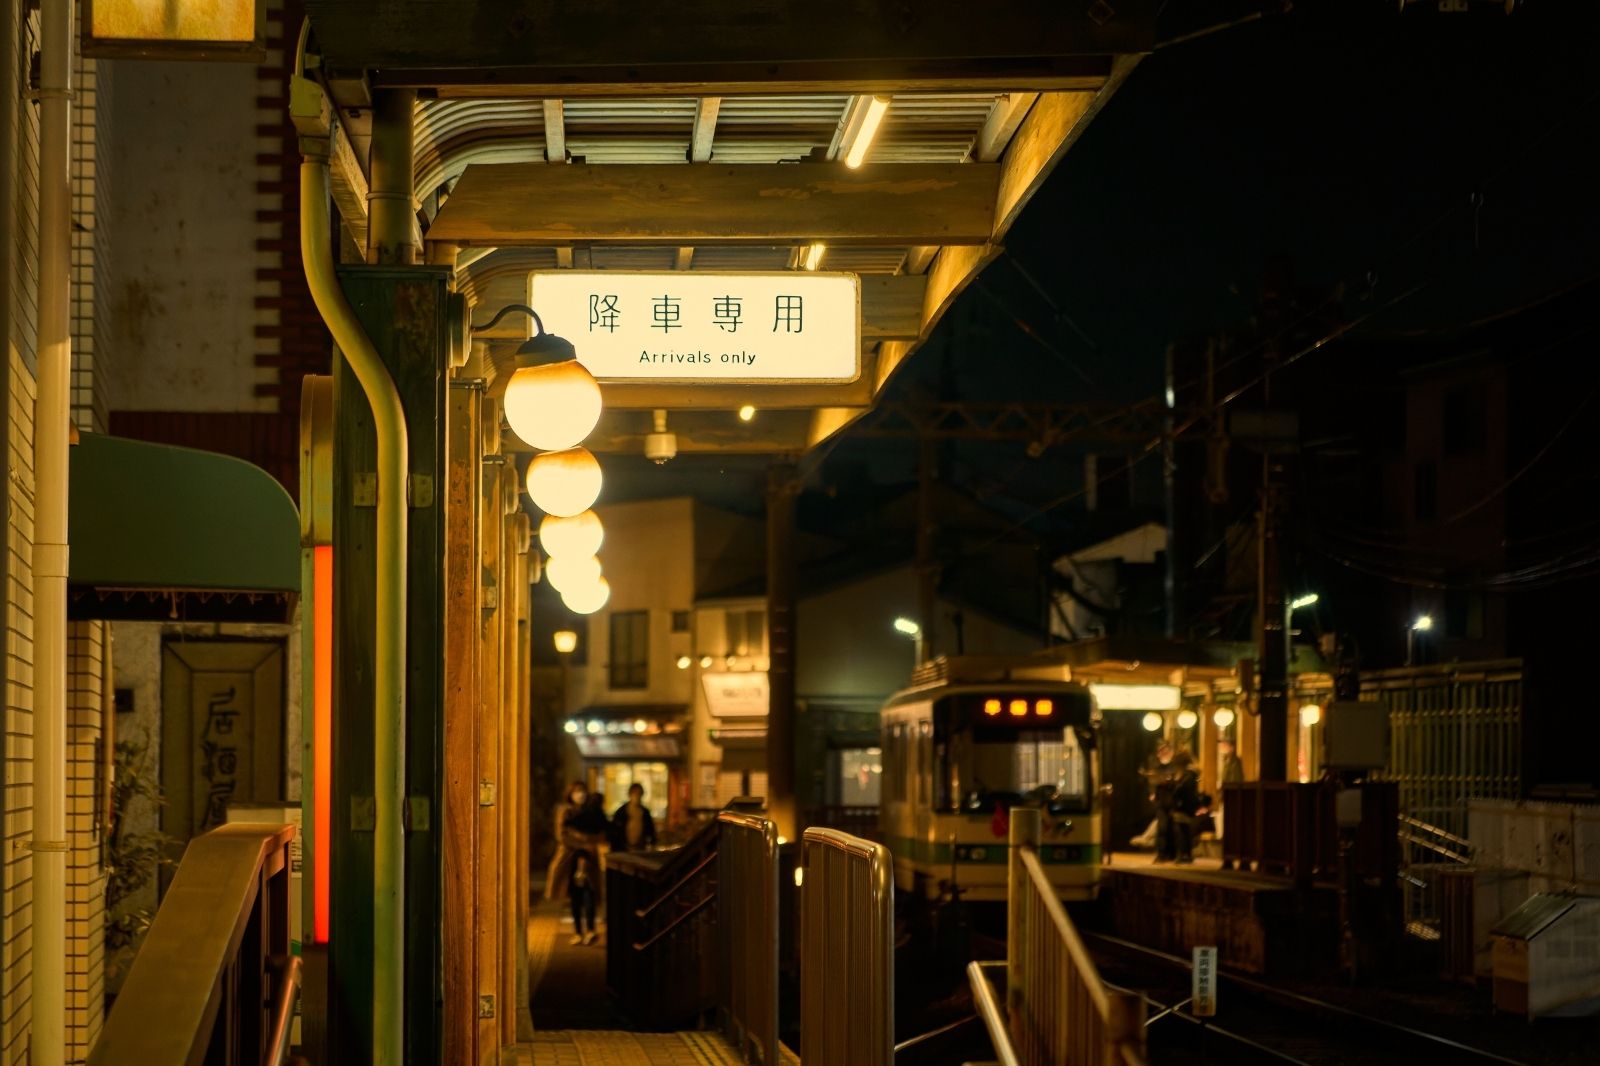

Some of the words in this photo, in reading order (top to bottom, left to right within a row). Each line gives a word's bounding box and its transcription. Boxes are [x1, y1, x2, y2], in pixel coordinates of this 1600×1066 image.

[589, 294, 803, 334] 降車専用
[639, 350, 712, 364] Arrivals
[720, 350, 757, 366] only
